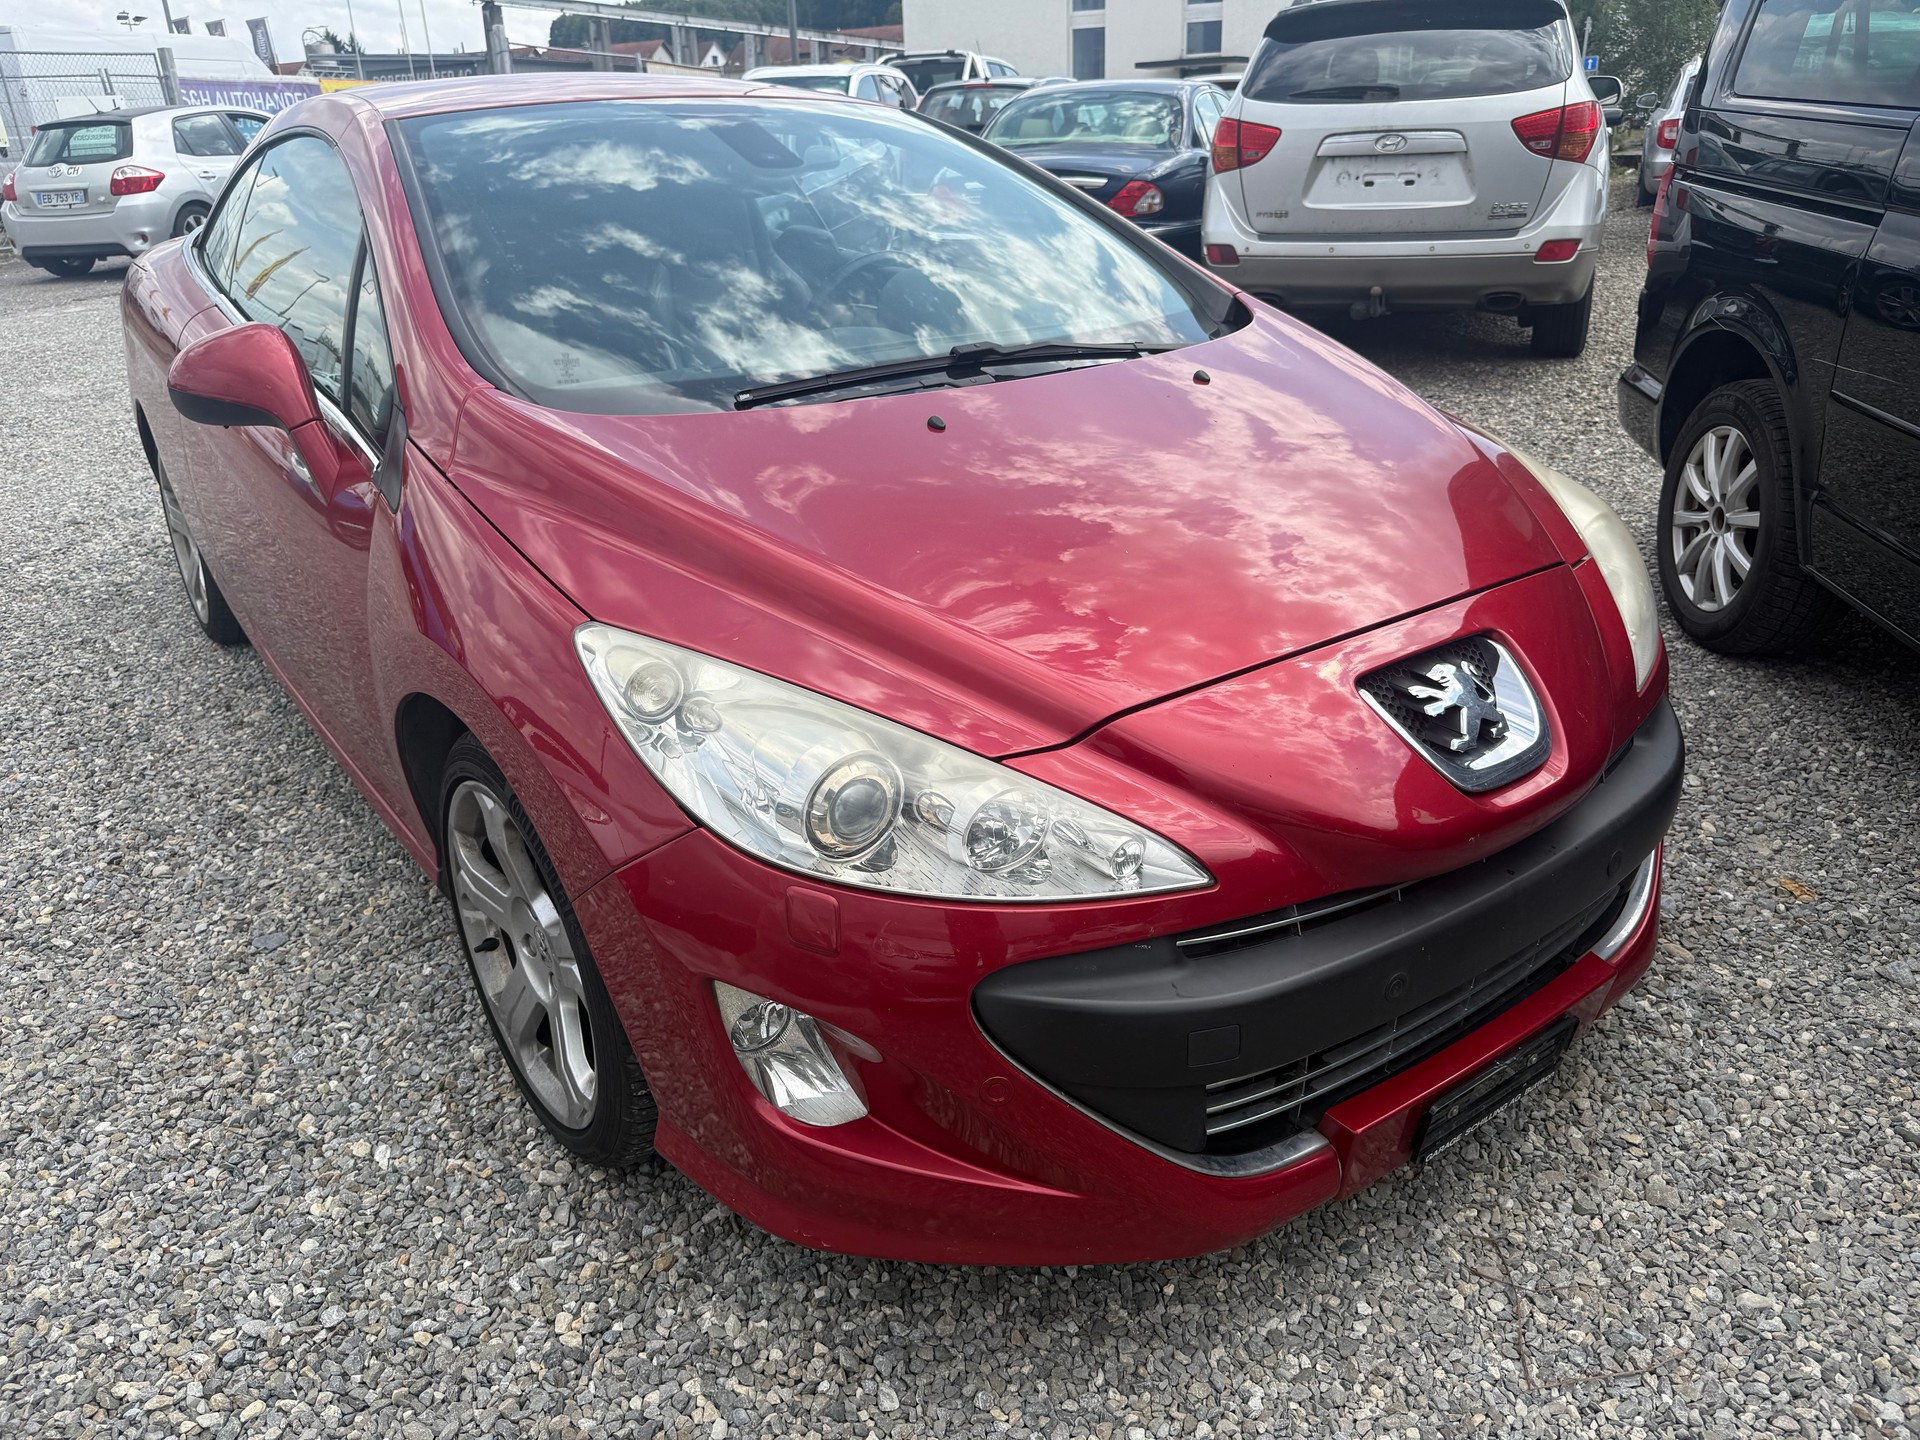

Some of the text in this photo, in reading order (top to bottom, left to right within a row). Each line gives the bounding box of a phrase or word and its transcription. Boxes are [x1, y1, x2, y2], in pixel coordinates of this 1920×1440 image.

[66, 167, 80, 175] CH
[42, 192, 80, 204] EB-753-YR
[1425, 1133, 1463, 1162] GARAGE
[1464, 1103, 1508, 1136] SCHILLING
[1508, 1093, 1522, 1106] AG
